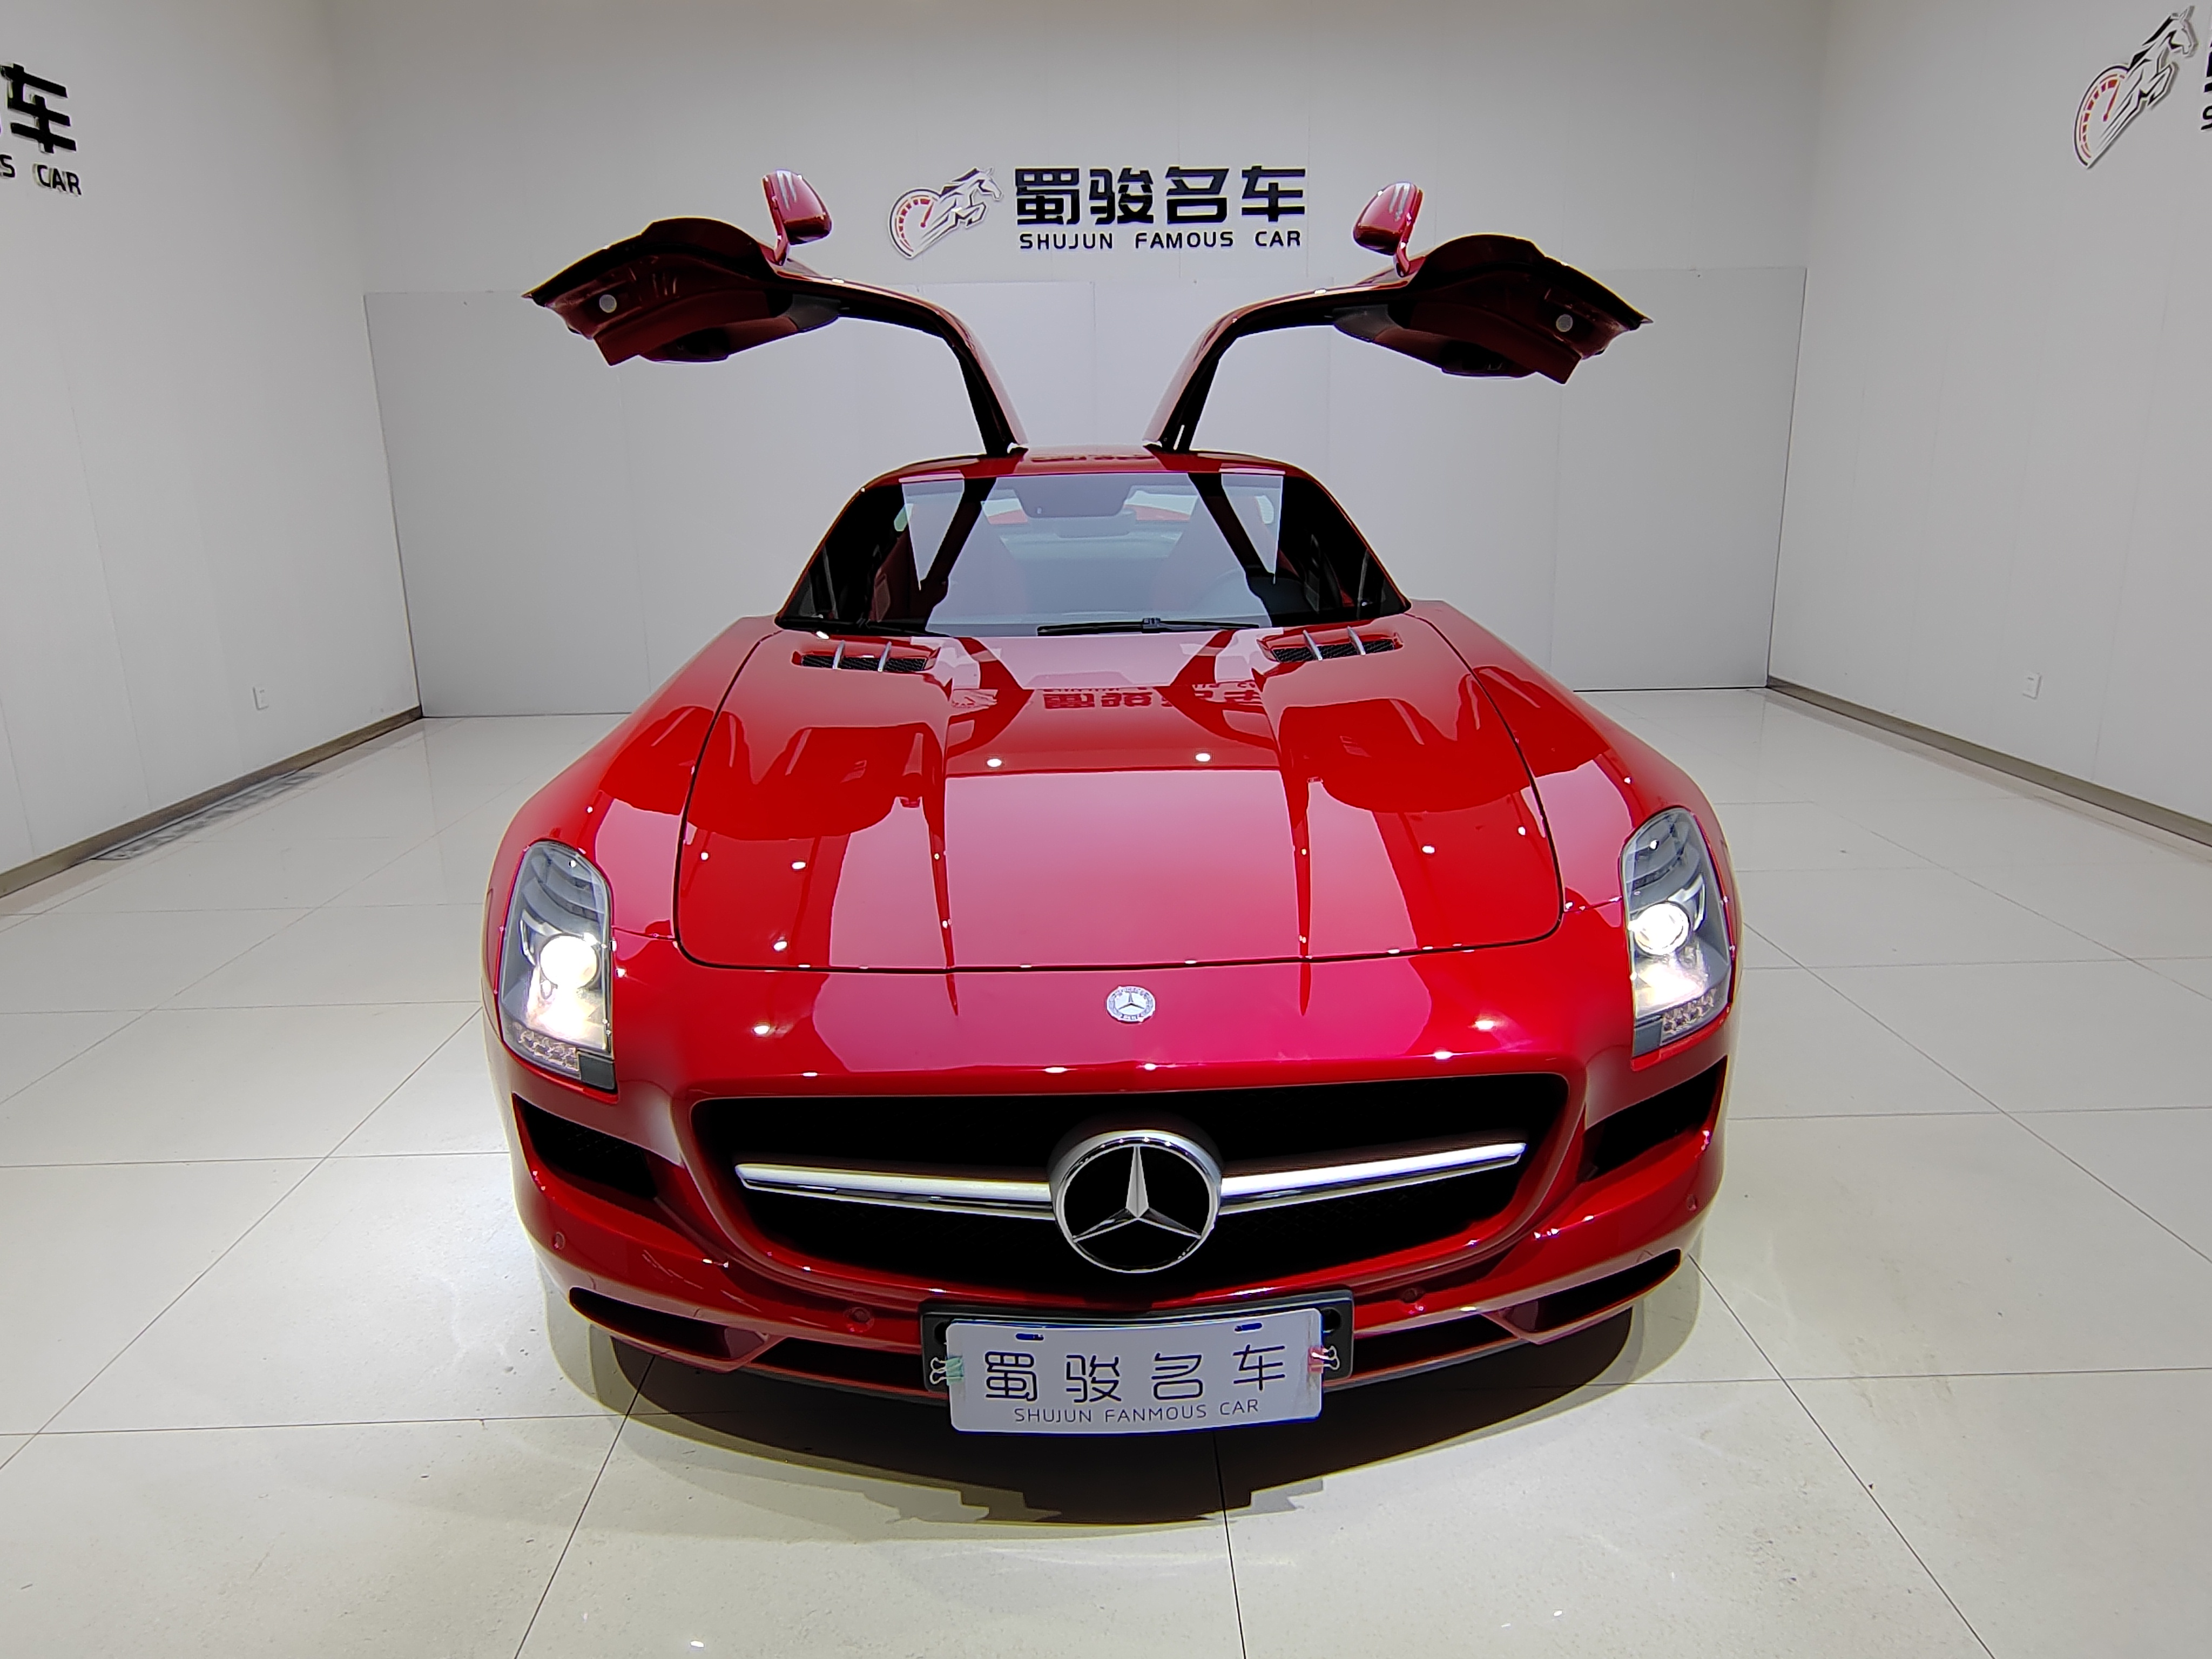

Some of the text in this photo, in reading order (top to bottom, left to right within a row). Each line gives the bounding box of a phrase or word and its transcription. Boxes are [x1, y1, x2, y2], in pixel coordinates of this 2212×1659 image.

[34, 163, 82, 197] CAR
[1015, 165, 1306, 225] 蜀骏名车
[1020, 230, 1300, 250] SHUJUN FAMOUS CAR
[984, 1344, 1286, 1404] 蜀骏名车
[1014, 1399, 1258, 1423] SHUJUN FANMOUS CAR
